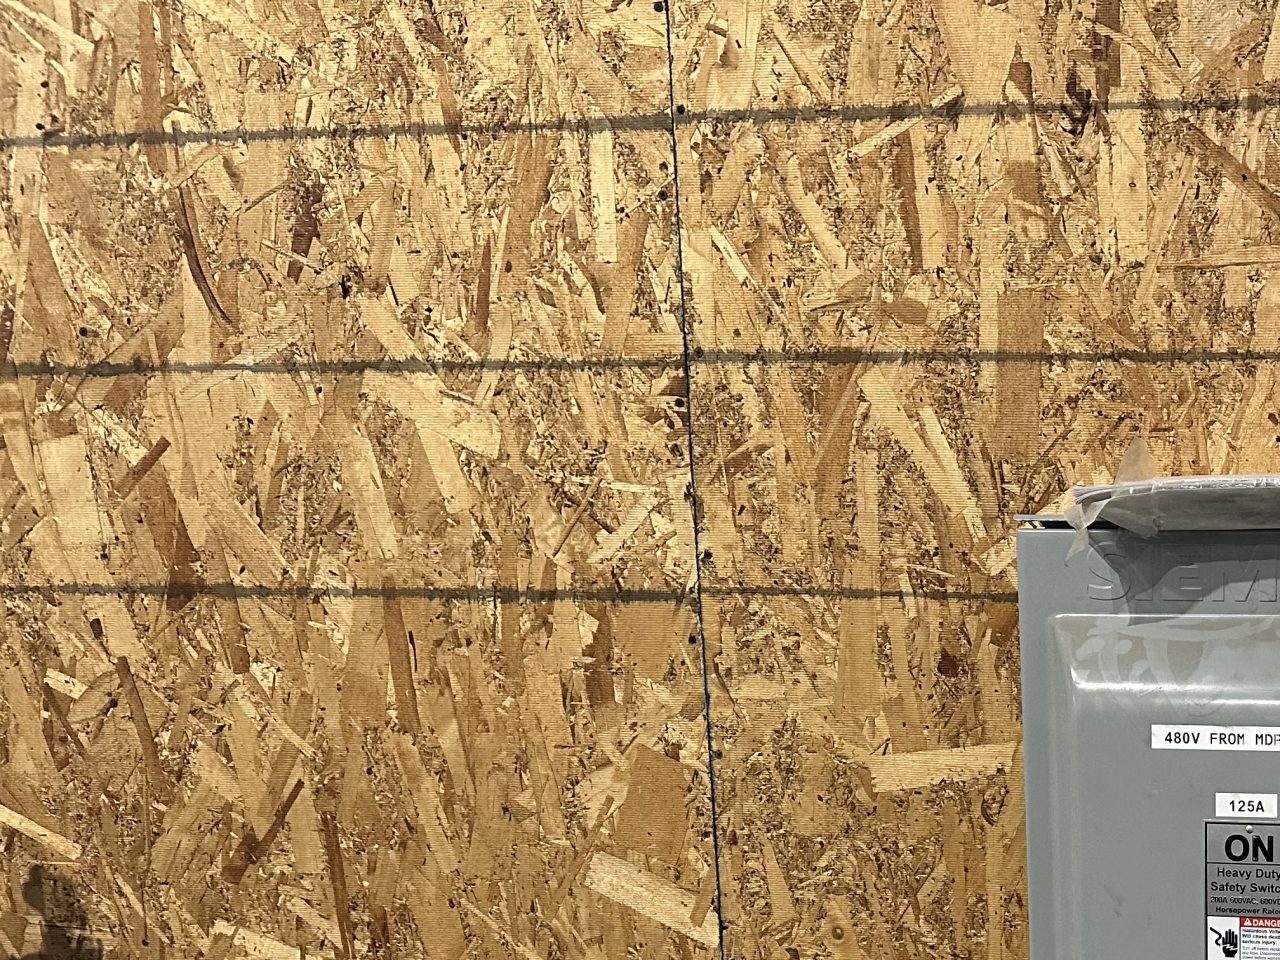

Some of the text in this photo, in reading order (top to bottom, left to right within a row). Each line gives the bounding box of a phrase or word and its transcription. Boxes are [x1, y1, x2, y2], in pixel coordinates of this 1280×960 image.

[1164, 731, 1201, 744] 480V
[1210, 732, 1245, 745] FROM
[1229, 800, 1265, 813] 125A
[1224, 834, 1274, 862] ON
[1217, 867, 1252, 880] Heavy
[1210, 881, 1246, 894] Safety
[1215, 906, 1260, 914] Horsepower
